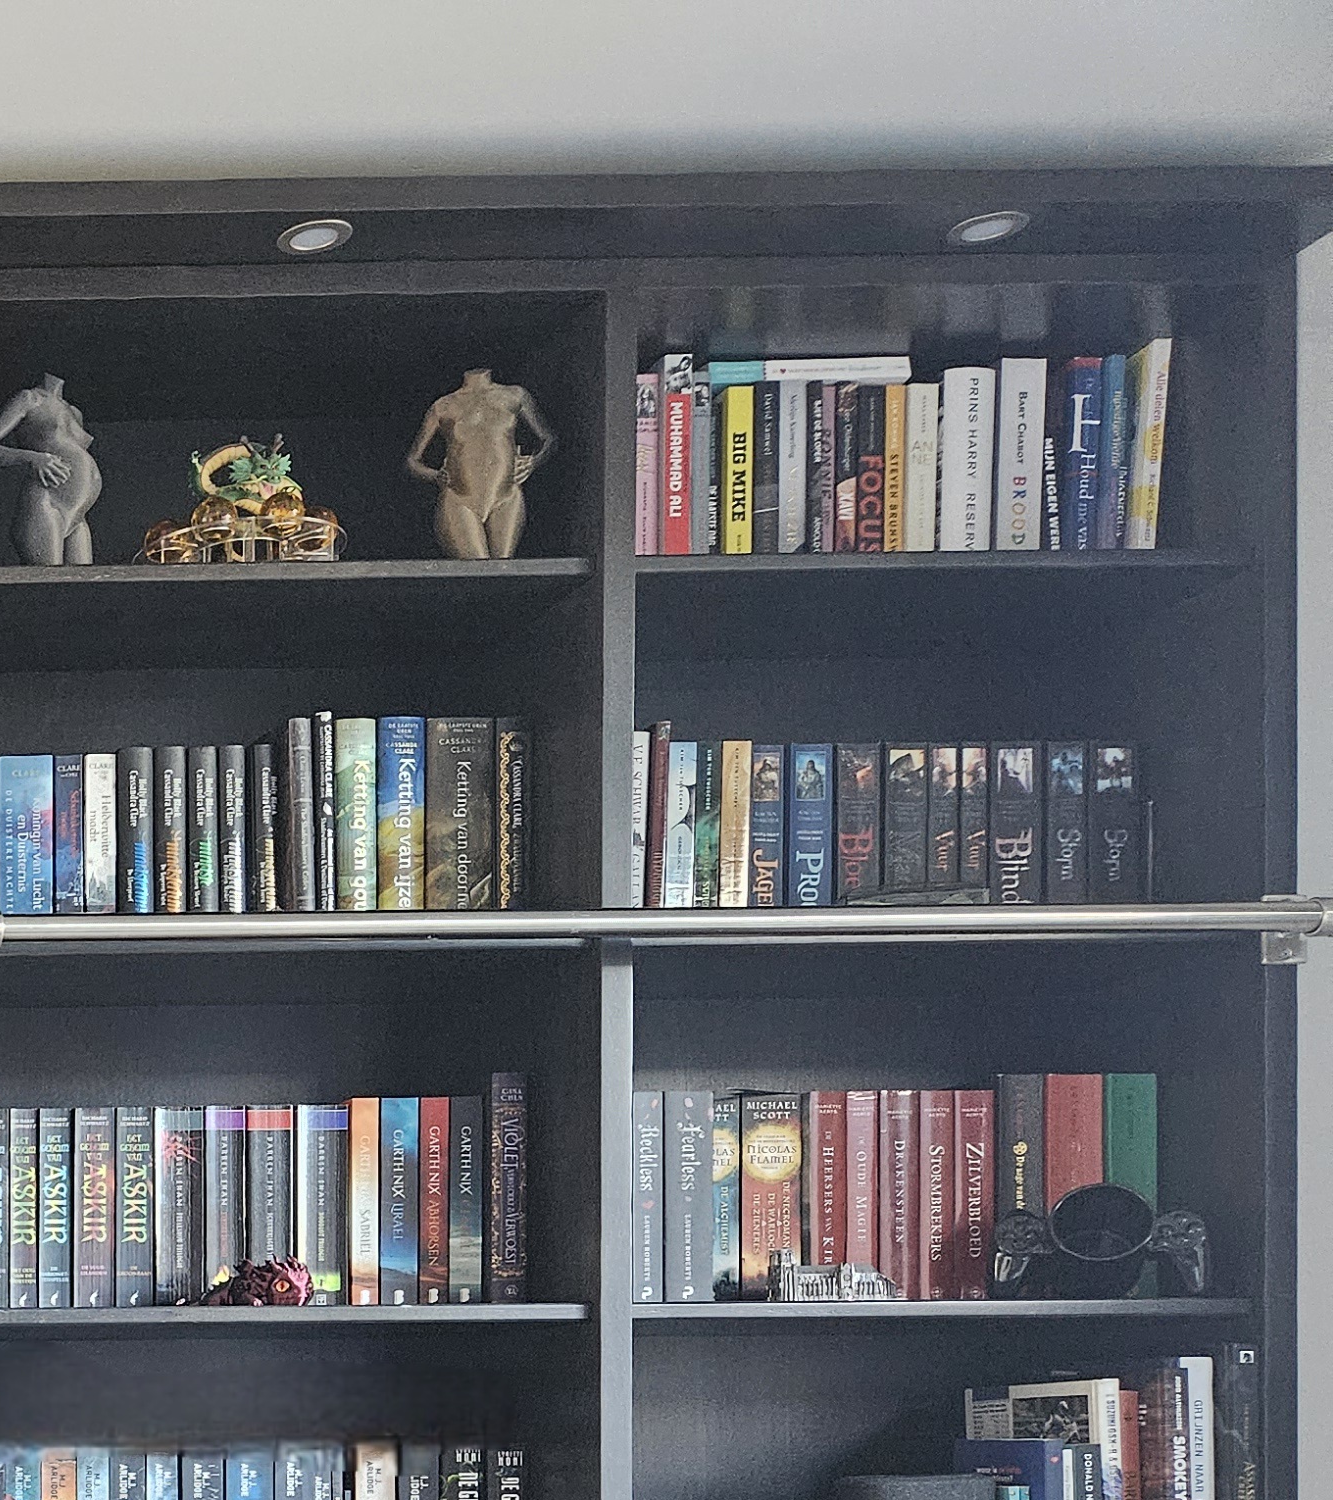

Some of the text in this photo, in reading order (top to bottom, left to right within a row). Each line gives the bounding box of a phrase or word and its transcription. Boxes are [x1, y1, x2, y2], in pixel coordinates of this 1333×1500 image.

[669, 403, 682, 517] MUHAMMAD ALI
[732, 433, 746, 521] BIG MIKE
[839, 493, 854, 520] XAVI
[17, 815, 29, 893] en Duisternis
[89, 810, 98, 843] macht
[100, 796, 111, 859] Heldenwitte
[935, 830, 953, 871] Vuur
[967, 830, 986, 869] Vuur
[1057, 829, 1081, 880] Storm
[1104, 829, 1128, 882] Storm
[1003, 828, 1033, 904] Blind
[746, 1102, 798, 1110] MICHAEL
[753, 1111, 791, 1120] SCOTT
[12, 1164, 37, 1245] ASKIR
[42, 1163, 67, 1244] ASKIR
[83, 1161, 108, 1243] ASKIR
[121, 1163, 147, 1244] ASKIR
[894, 1139, 906, 1243] DRAKENSTEEN
[929, 1145, 945, 1262] STORMBREKERS
[966, 1142, 984, 1259] ZILVERBLOED
[1083, 1453, 1094, 1488] DONALD
